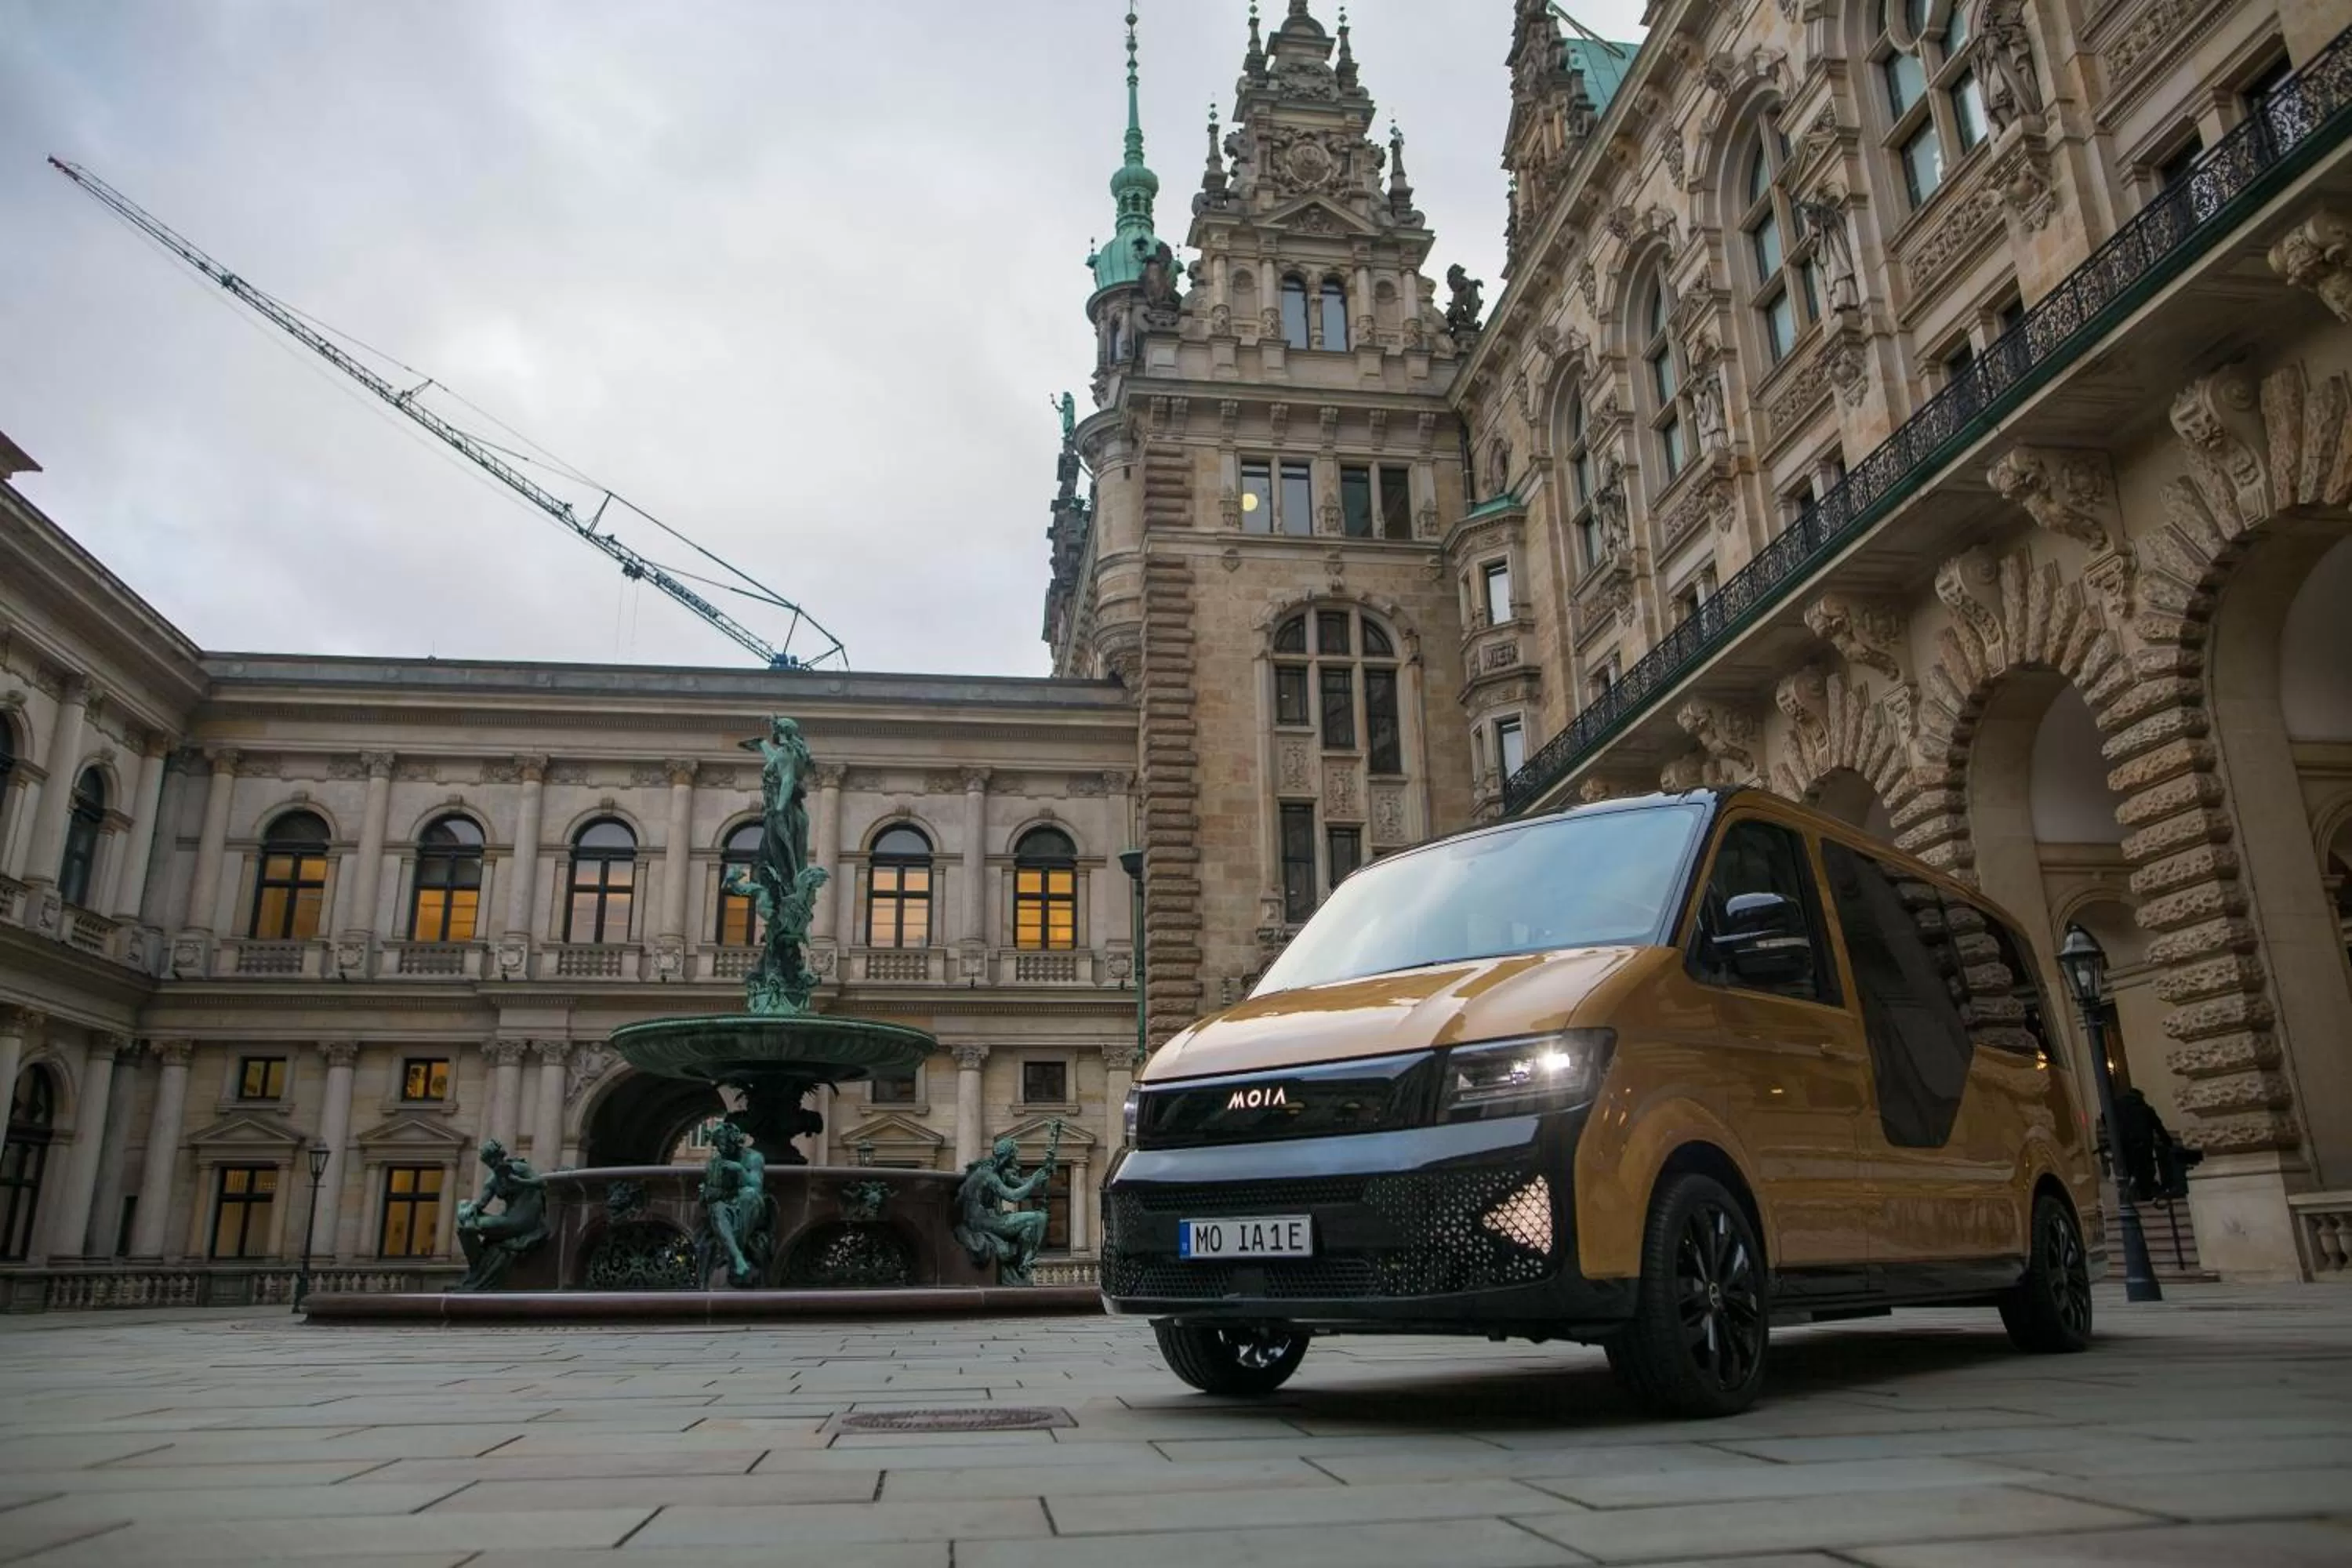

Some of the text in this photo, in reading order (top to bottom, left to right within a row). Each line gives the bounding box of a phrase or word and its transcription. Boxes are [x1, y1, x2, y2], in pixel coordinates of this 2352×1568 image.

[1227, 1086, 1287, 1110] MOIA
[1196, 1223, 1303, 1253] MO IA1E
